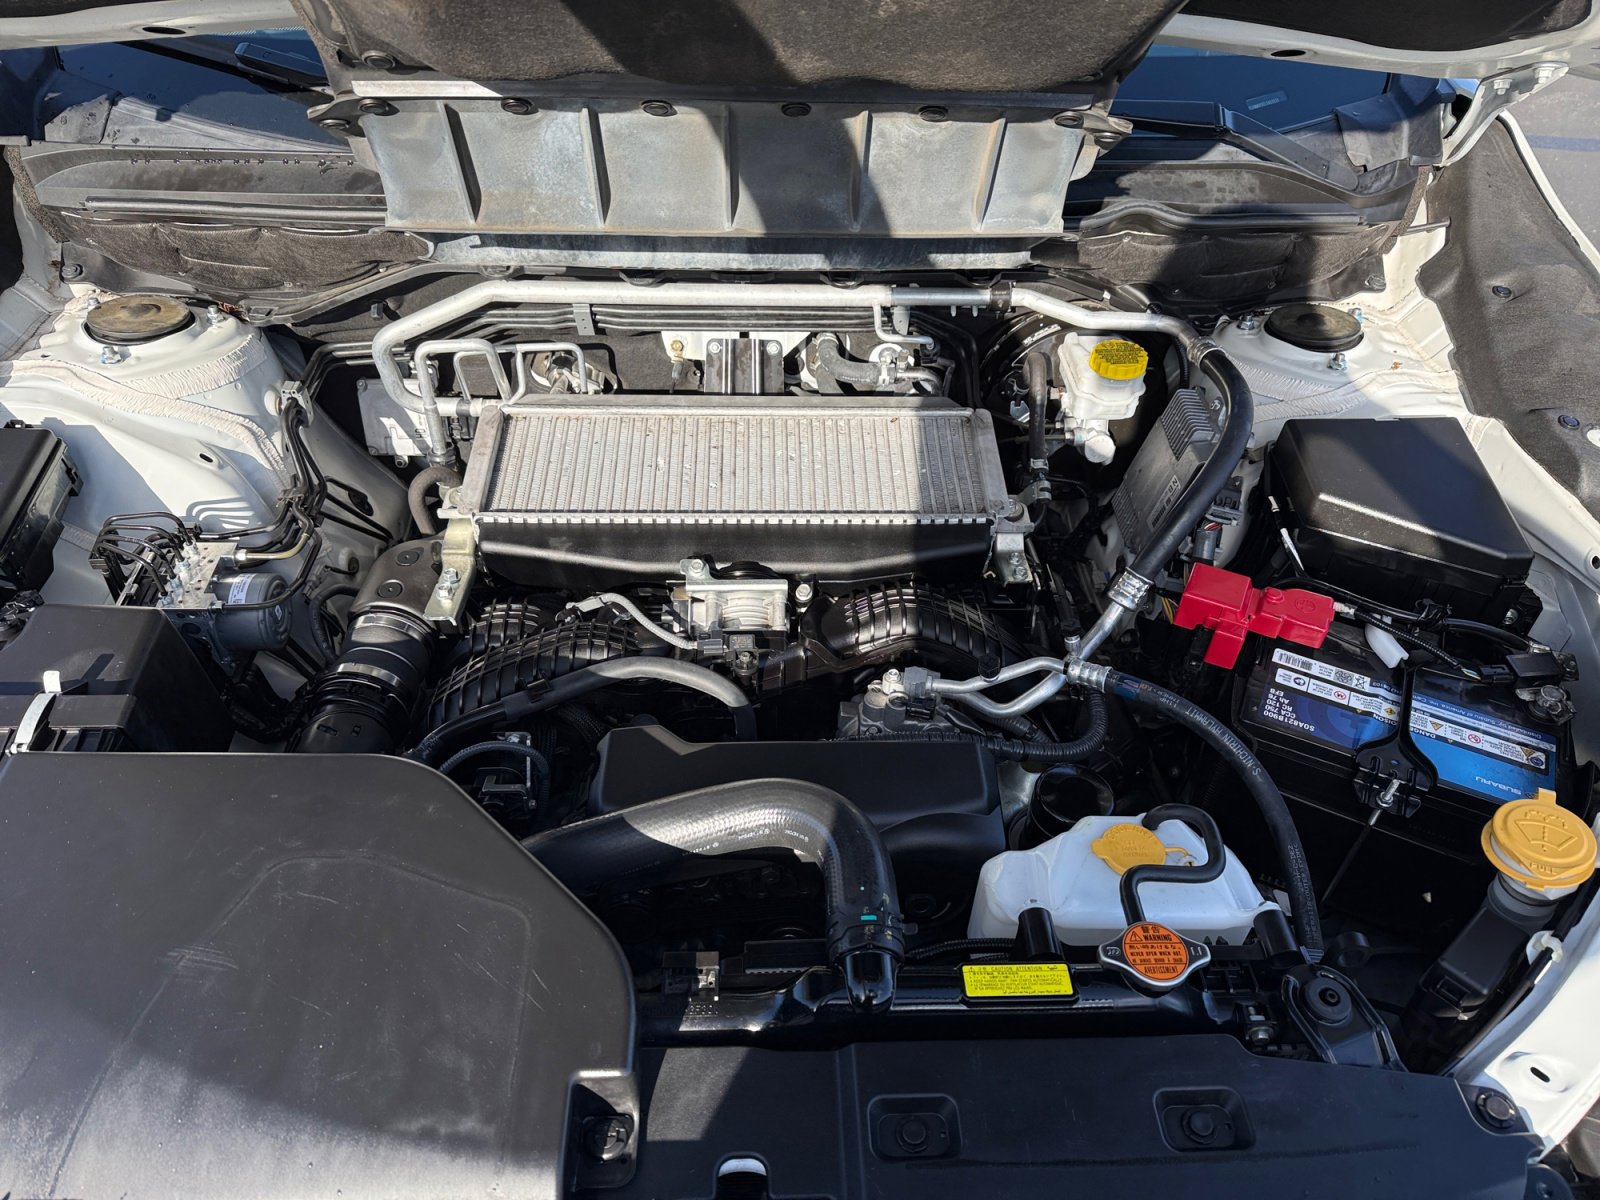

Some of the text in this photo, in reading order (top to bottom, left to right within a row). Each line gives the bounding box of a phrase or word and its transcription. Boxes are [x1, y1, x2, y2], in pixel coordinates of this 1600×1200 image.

[1270, 688, 1284, 696] EFB
[1264, 704, 1296, 719] CCA 750
[1266, 698, 1293, 712] RC 120
[1372, 713, 1398, 726] OISON
[1474, 714, 1496, 725] Subaru
[1410, 726, 1436, 739] DANGE
[1475, 776, 1522, 796] SUBARU
[1530, 862, 1557, 876] PULL
[1143, 934, 1172, 942] WARNING
